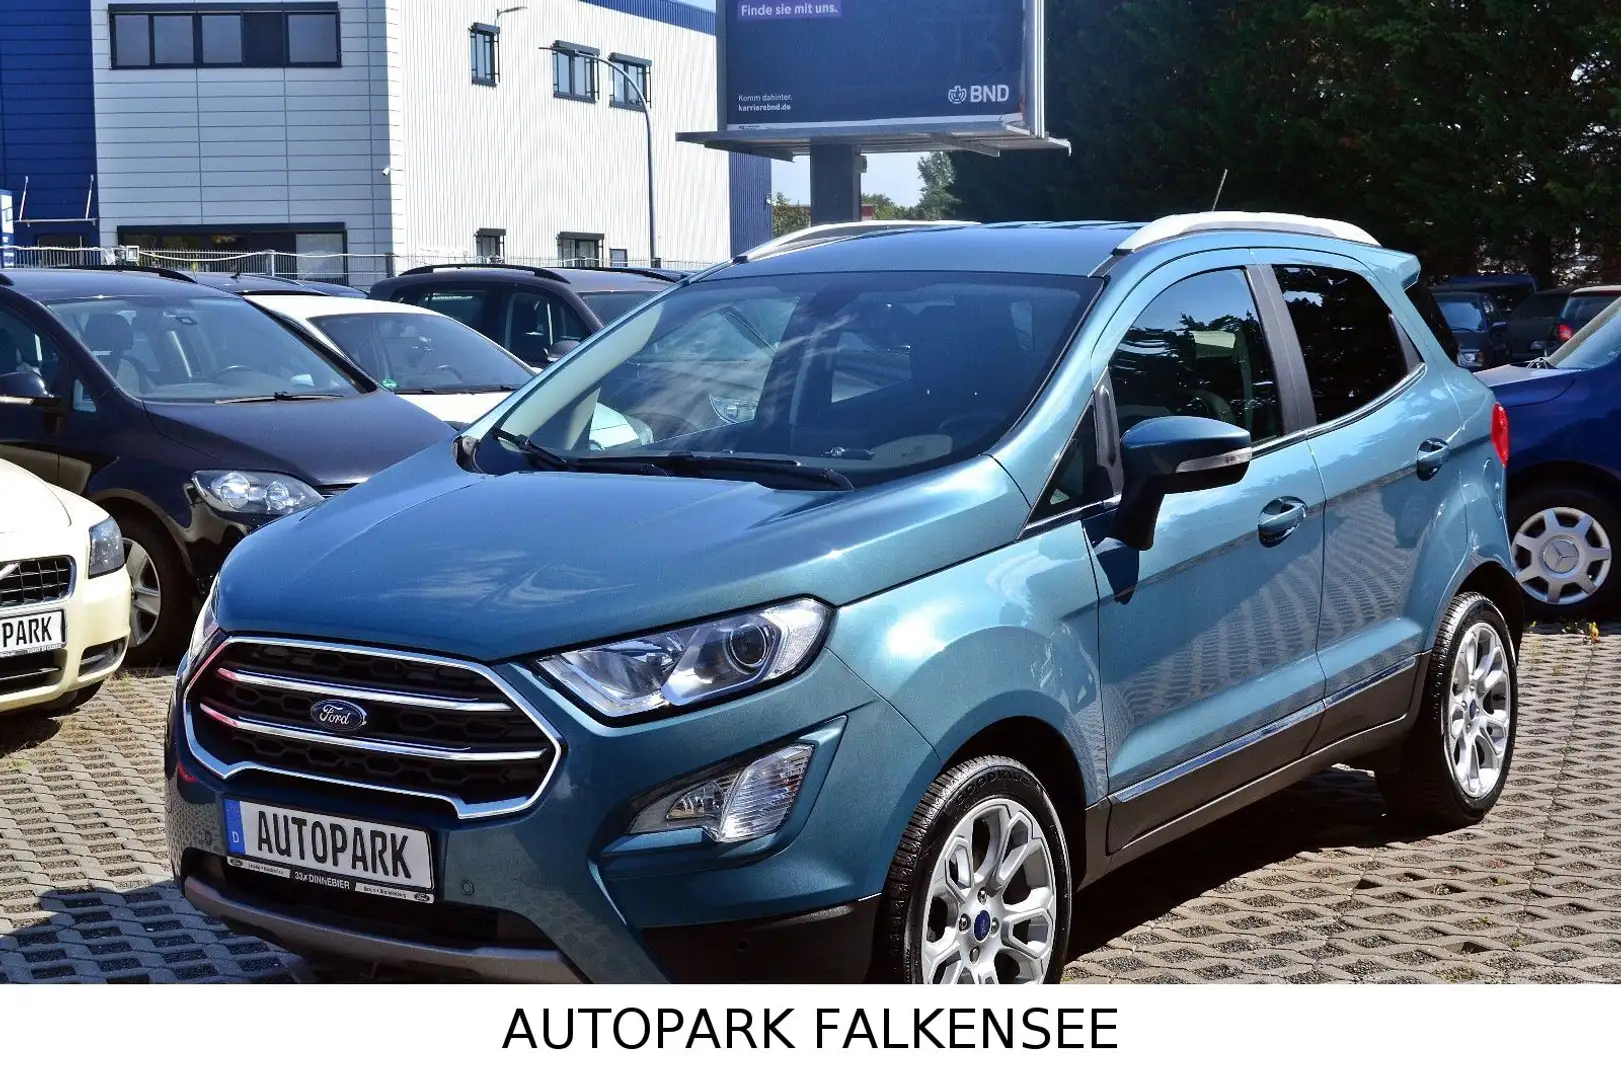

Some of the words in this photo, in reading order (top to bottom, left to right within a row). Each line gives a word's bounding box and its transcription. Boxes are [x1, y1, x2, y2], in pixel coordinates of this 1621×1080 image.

[741, 4, 773, 16] Finde
[775, 5, 792, 15] sie
[794, 3, 812, 14] mit
[815, 3, 838, 13] uns.
[762, 93, 793, 101] dahinter.
[970, 84, 1009, 103] BND
[738, 103, 791, 112] karrierebnd.de
[2, 616, 52, 647] PARK
[320, 704, 351, 724] Ford
[232, 831, 239, 843] D
[258, 810, 411, 879] AUTOPARK
[309, 874, 350, 889] DINNEBIER
